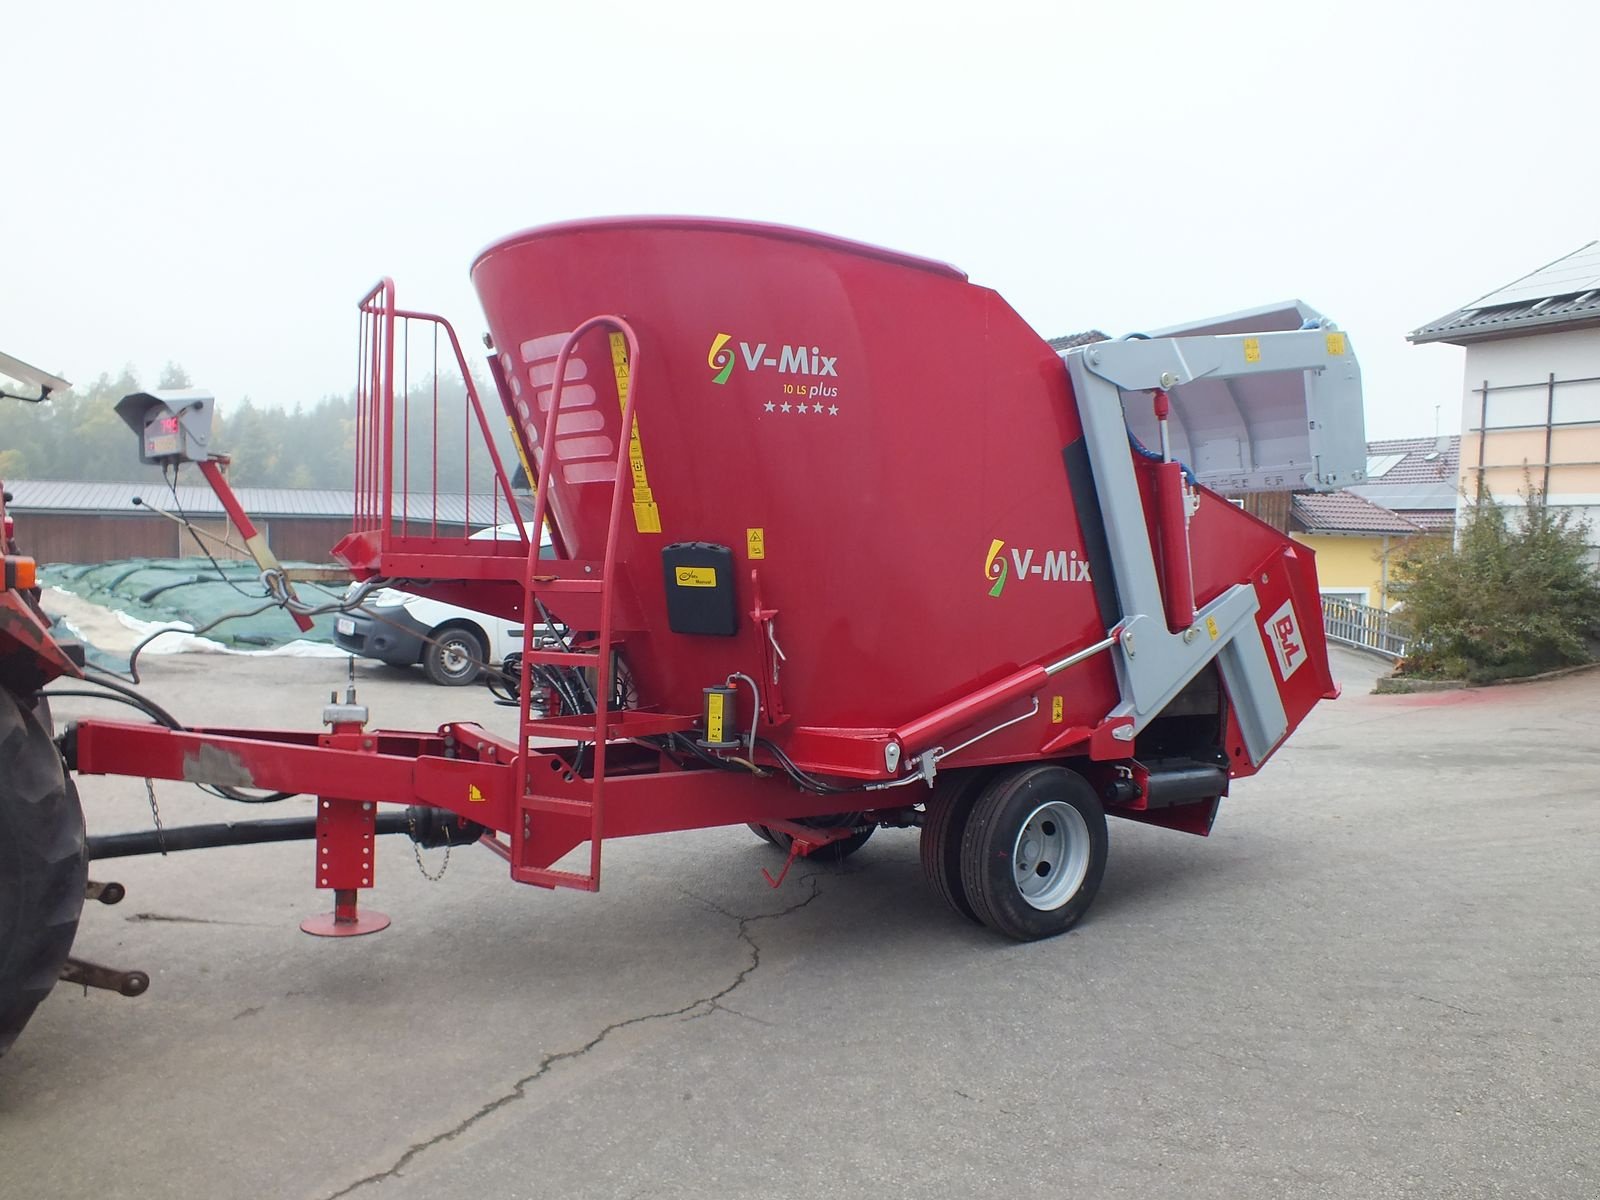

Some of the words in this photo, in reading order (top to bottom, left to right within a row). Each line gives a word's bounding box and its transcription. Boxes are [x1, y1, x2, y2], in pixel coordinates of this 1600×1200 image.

[739, 342, 838, 377] V-Mix
[783, 384, 793, 394] 10
[796, 384, 807, 395] LS
[809, 382, 838, 399] plus
[1011, 548, 1093, 582] V-Mix
